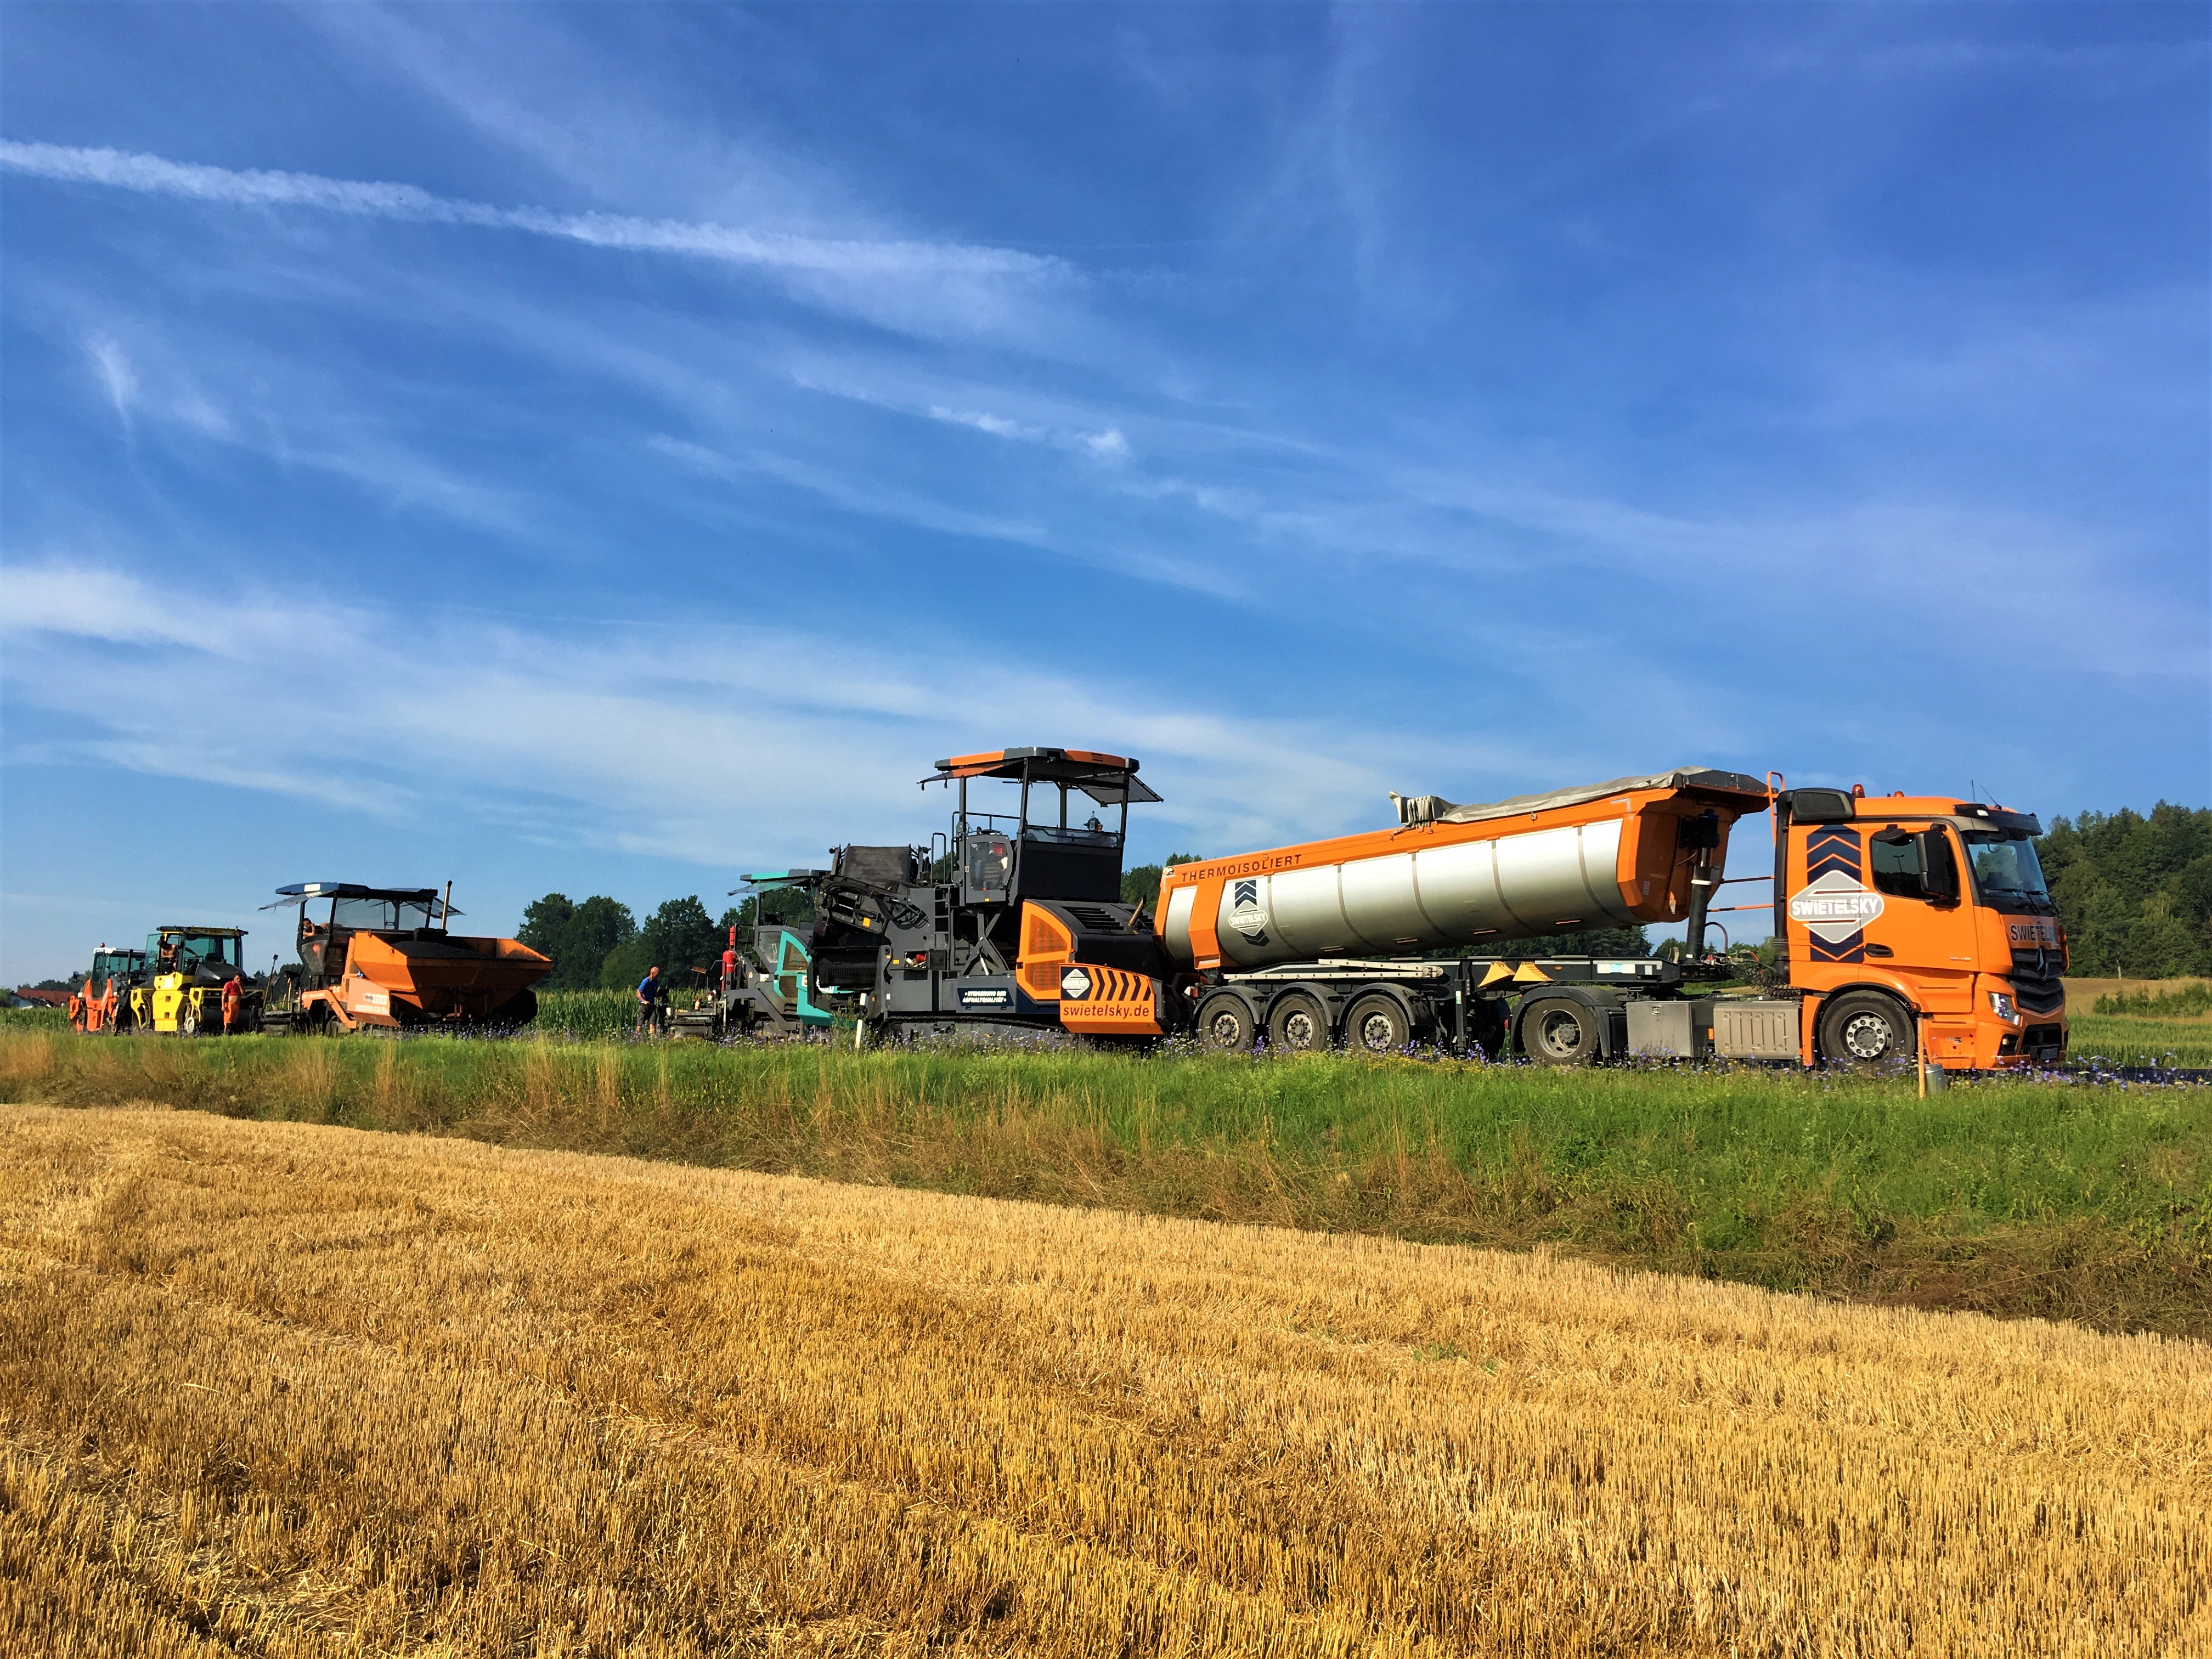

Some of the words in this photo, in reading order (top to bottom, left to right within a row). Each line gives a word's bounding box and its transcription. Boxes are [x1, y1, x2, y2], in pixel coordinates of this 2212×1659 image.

[1182, 854, 1302, 882] THERMOISOLIERT
[1792, 898, 1879, 916] SWIETELSKY
[1231, 912, 1266, 926] SWIETELSKY
[1063, 1004, 1149, 1019] swietelsky.de
